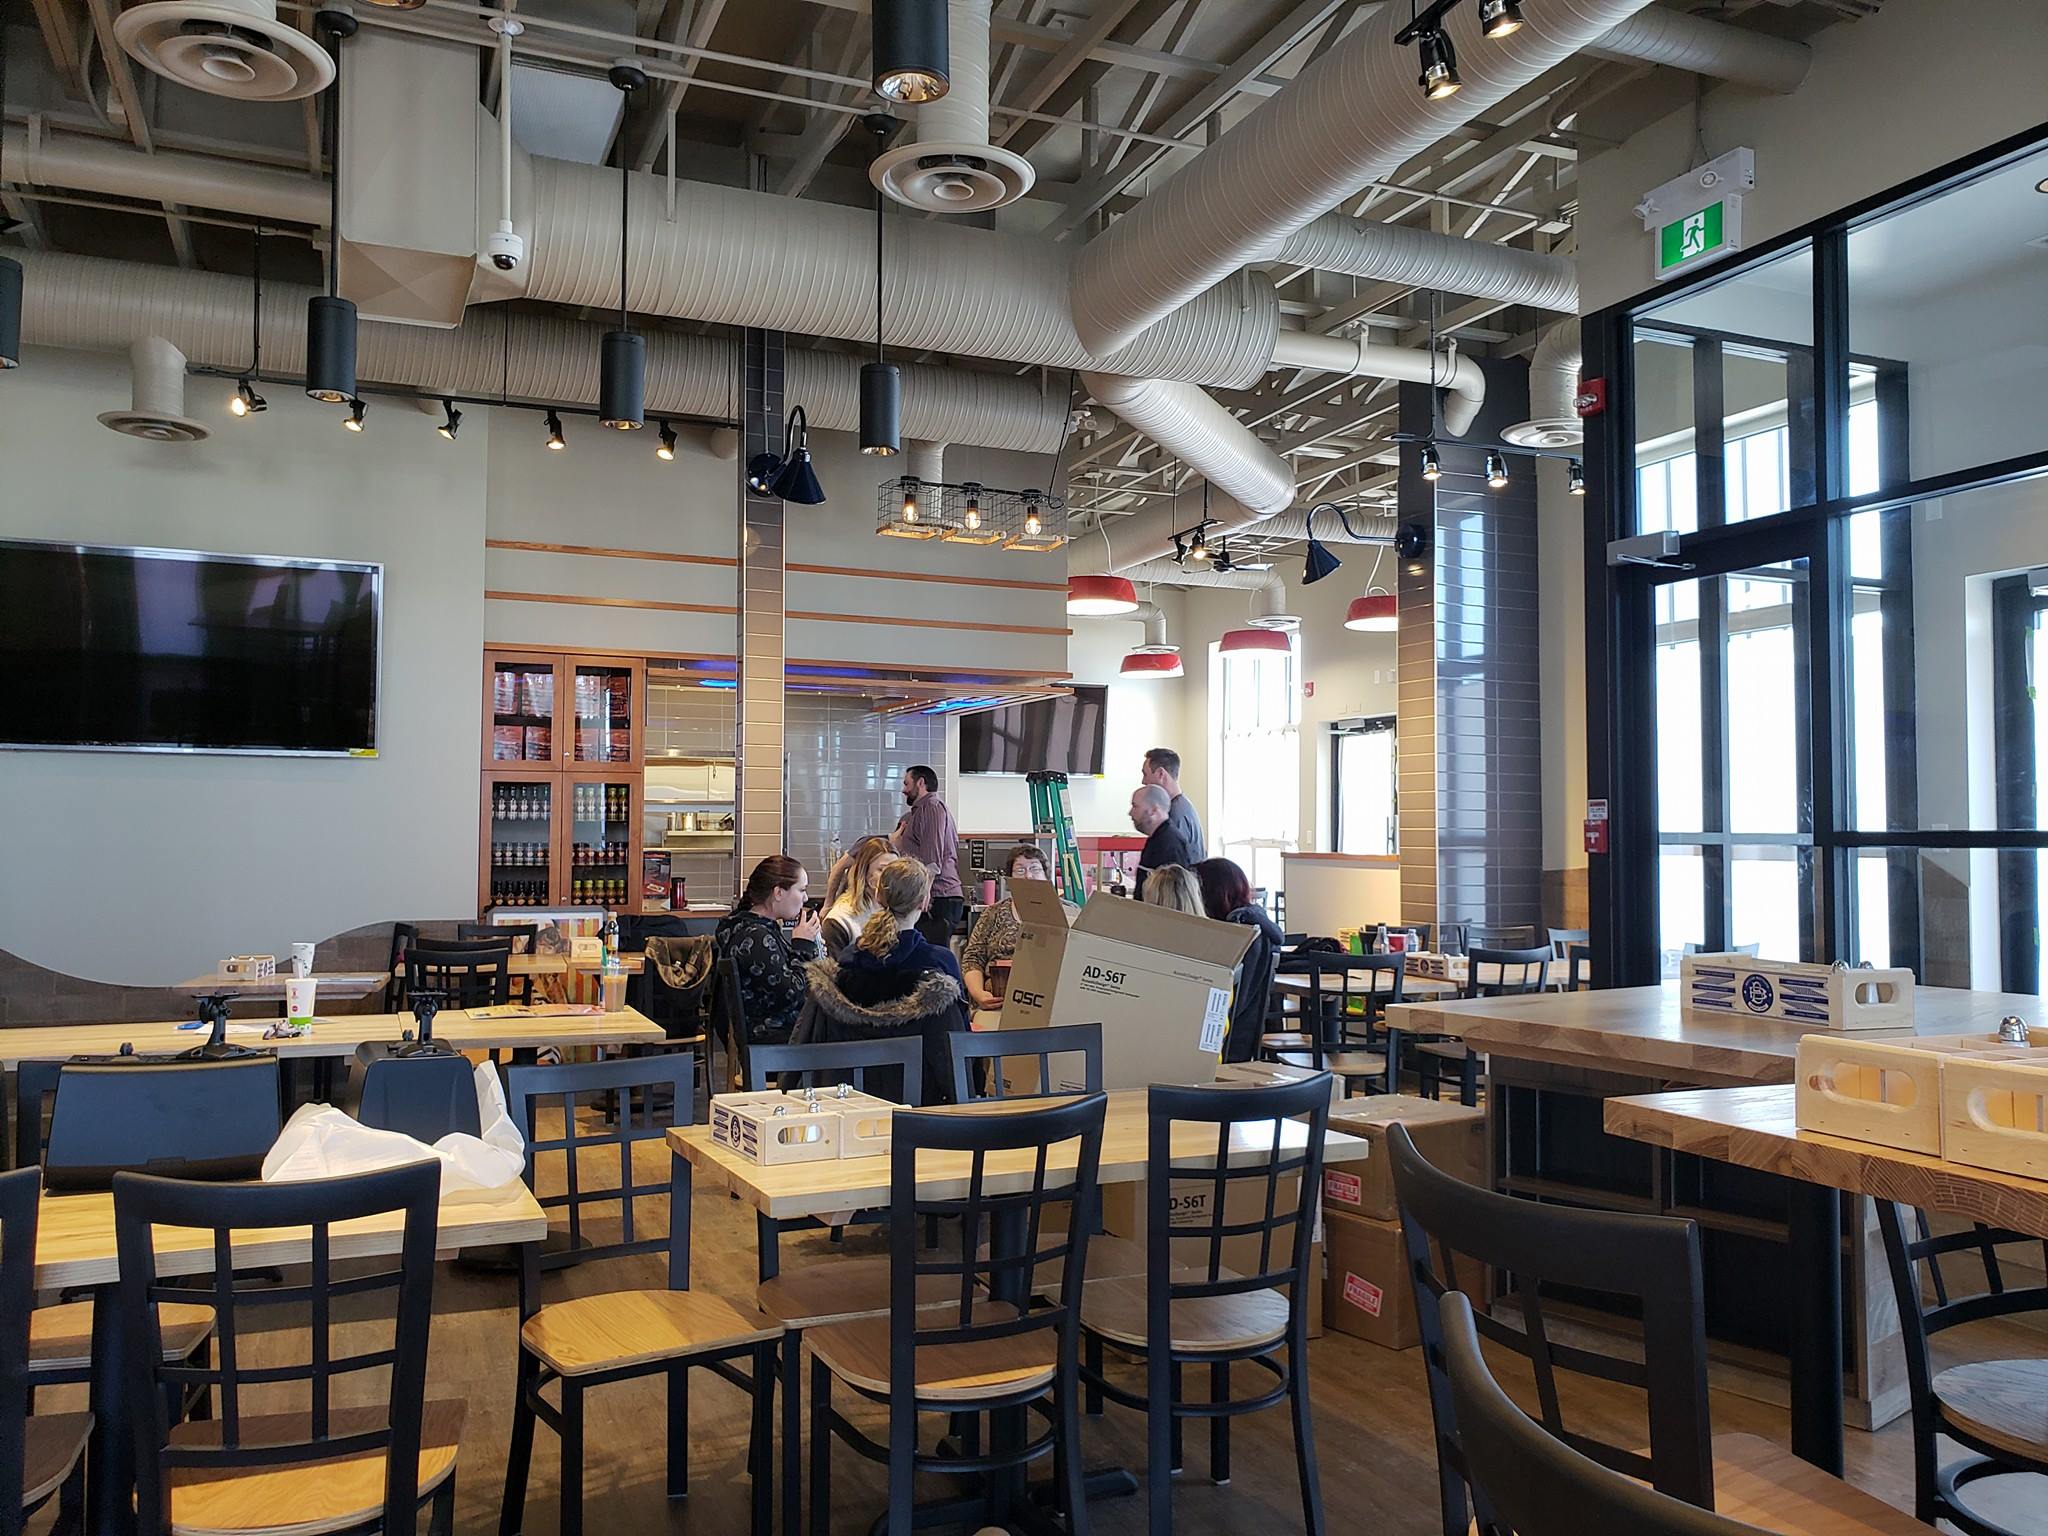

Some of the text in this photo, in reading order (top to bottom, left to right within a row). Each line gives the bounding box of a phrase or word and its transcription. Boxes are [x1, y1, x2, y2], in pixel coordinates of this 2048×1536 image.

[1082, 965, 1127, 985] AD-S6T
[1012, 989, 1045, 1008] QSC
[1169, 1194, 1207, 1210] D-S6T
